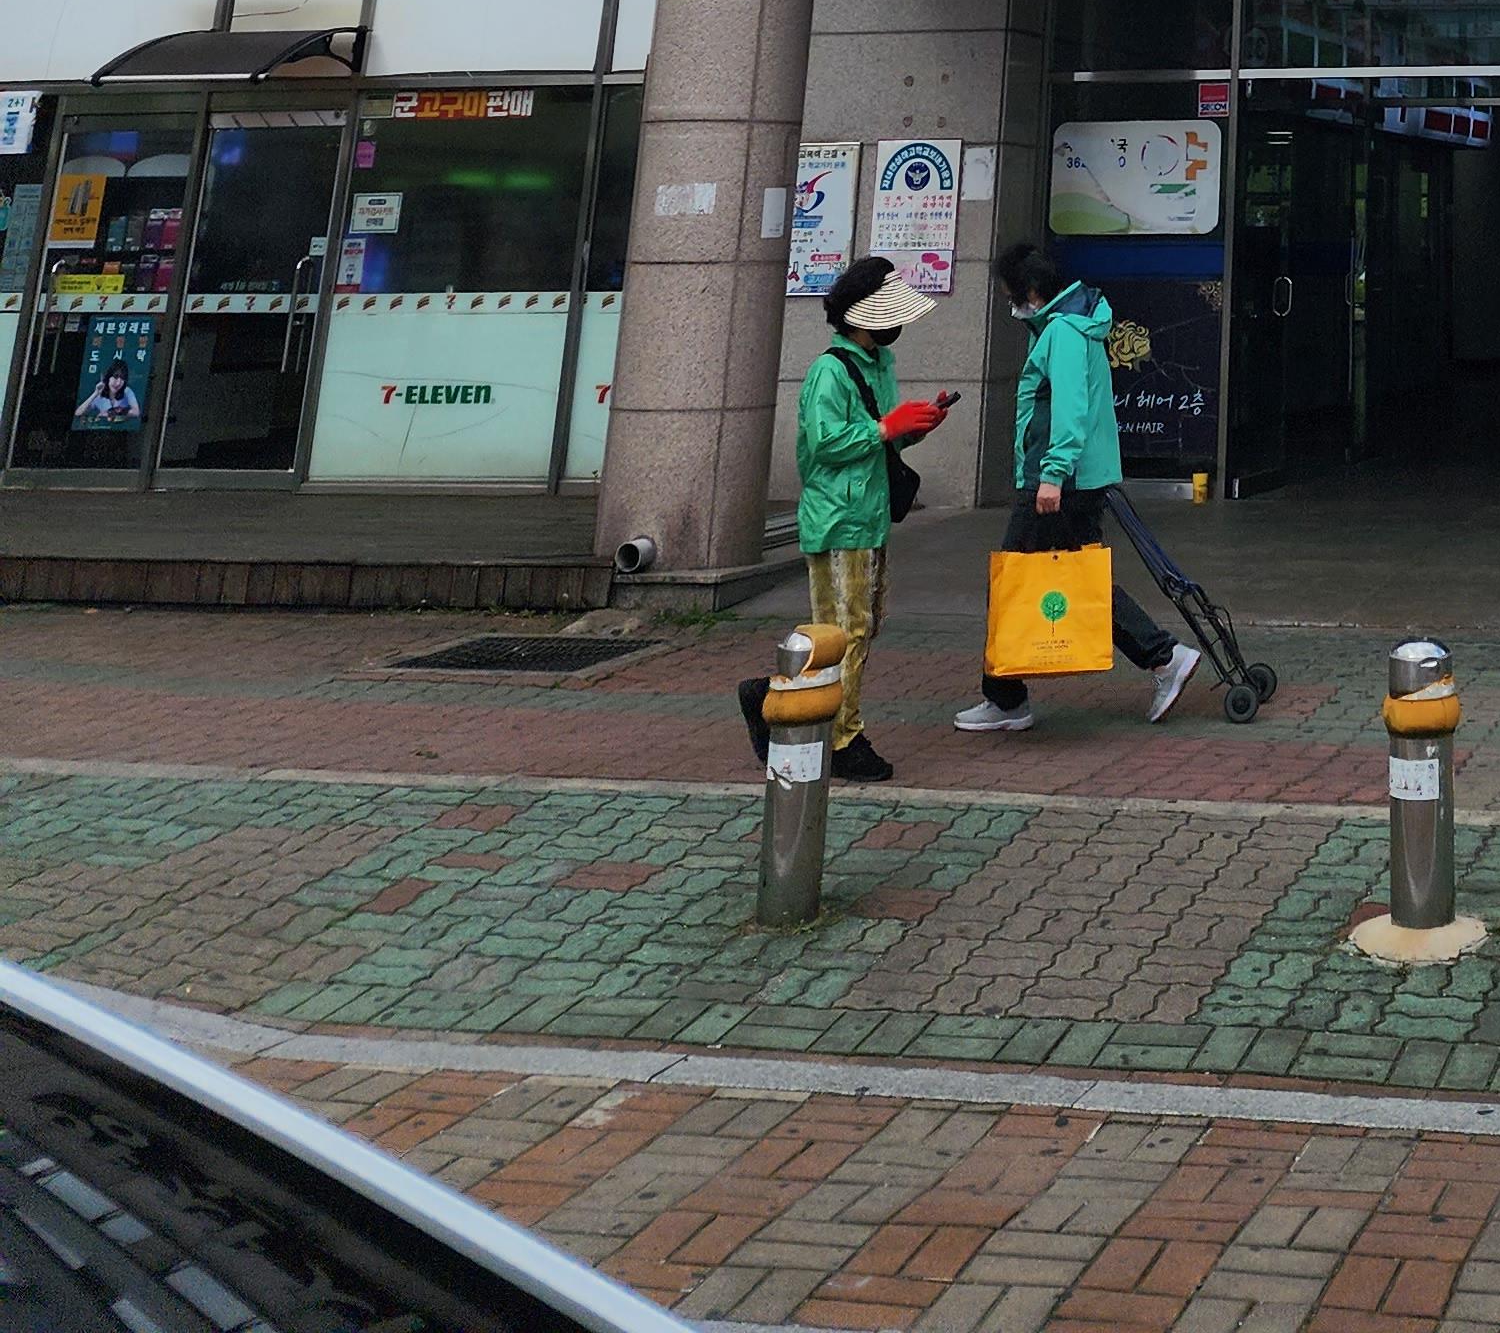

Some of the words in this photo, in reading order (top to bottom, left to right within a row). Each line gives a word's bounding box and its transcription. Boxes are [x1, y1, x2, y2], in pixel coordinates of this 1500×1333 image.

[8, 98, 25, 108] 2+1
[394, 89, 534, 118] 군고구마판매
[1200, 103, 1227, 111] SECOM
[95, 322, 150, 334] 세븐일레븐
[1178, 389, 1205, 415] 2층
[1136, 422, 1164, 433] HAIR
